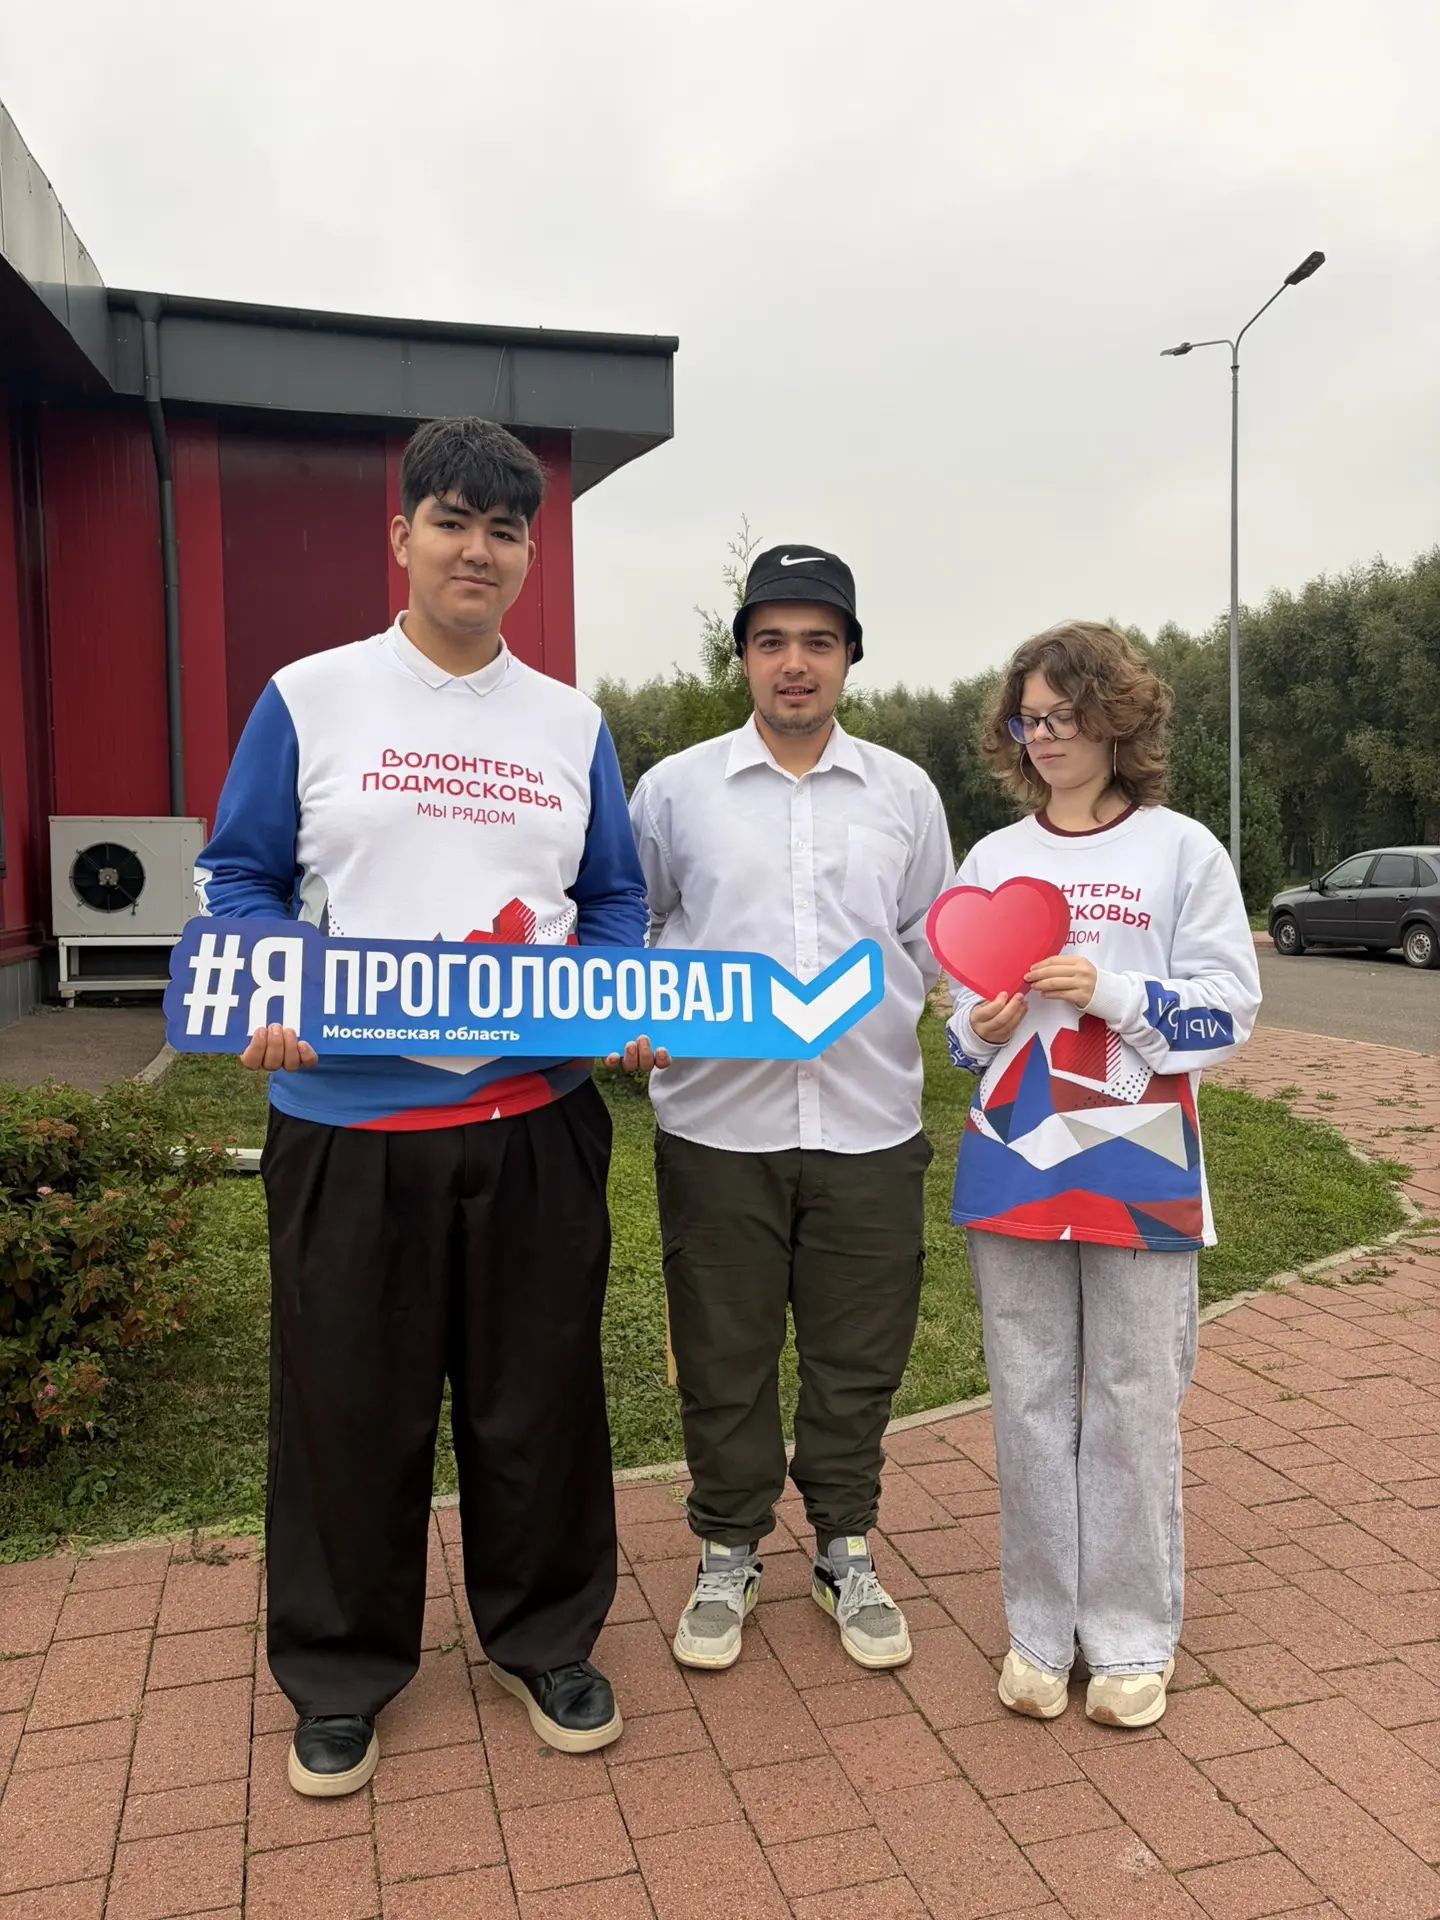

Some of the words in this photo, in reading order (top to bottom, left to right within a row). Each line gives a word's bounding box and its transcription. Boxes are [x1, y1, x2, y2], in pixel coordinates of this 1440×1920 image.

[381, 748, 545, 786] ВОЛОНТЕРЫ
[361, 772, 564, 812] ПОДМОСКОВЬЯ
[416, 802, 448, 819] МЫ
[451, 806, 517, 826] РЯДОМ
[1061, 883, 1142, 903] НТЕРЫ
[1064, 930, 1101, 947] ДОМ
[183, 933, 304, 1038] #Я
[323, 949, 754, 1023] ПРОГОЛОСОВАЛ
[322, 1024, 441, 1040] Московская
[444, 1026, 522, 1042] область
